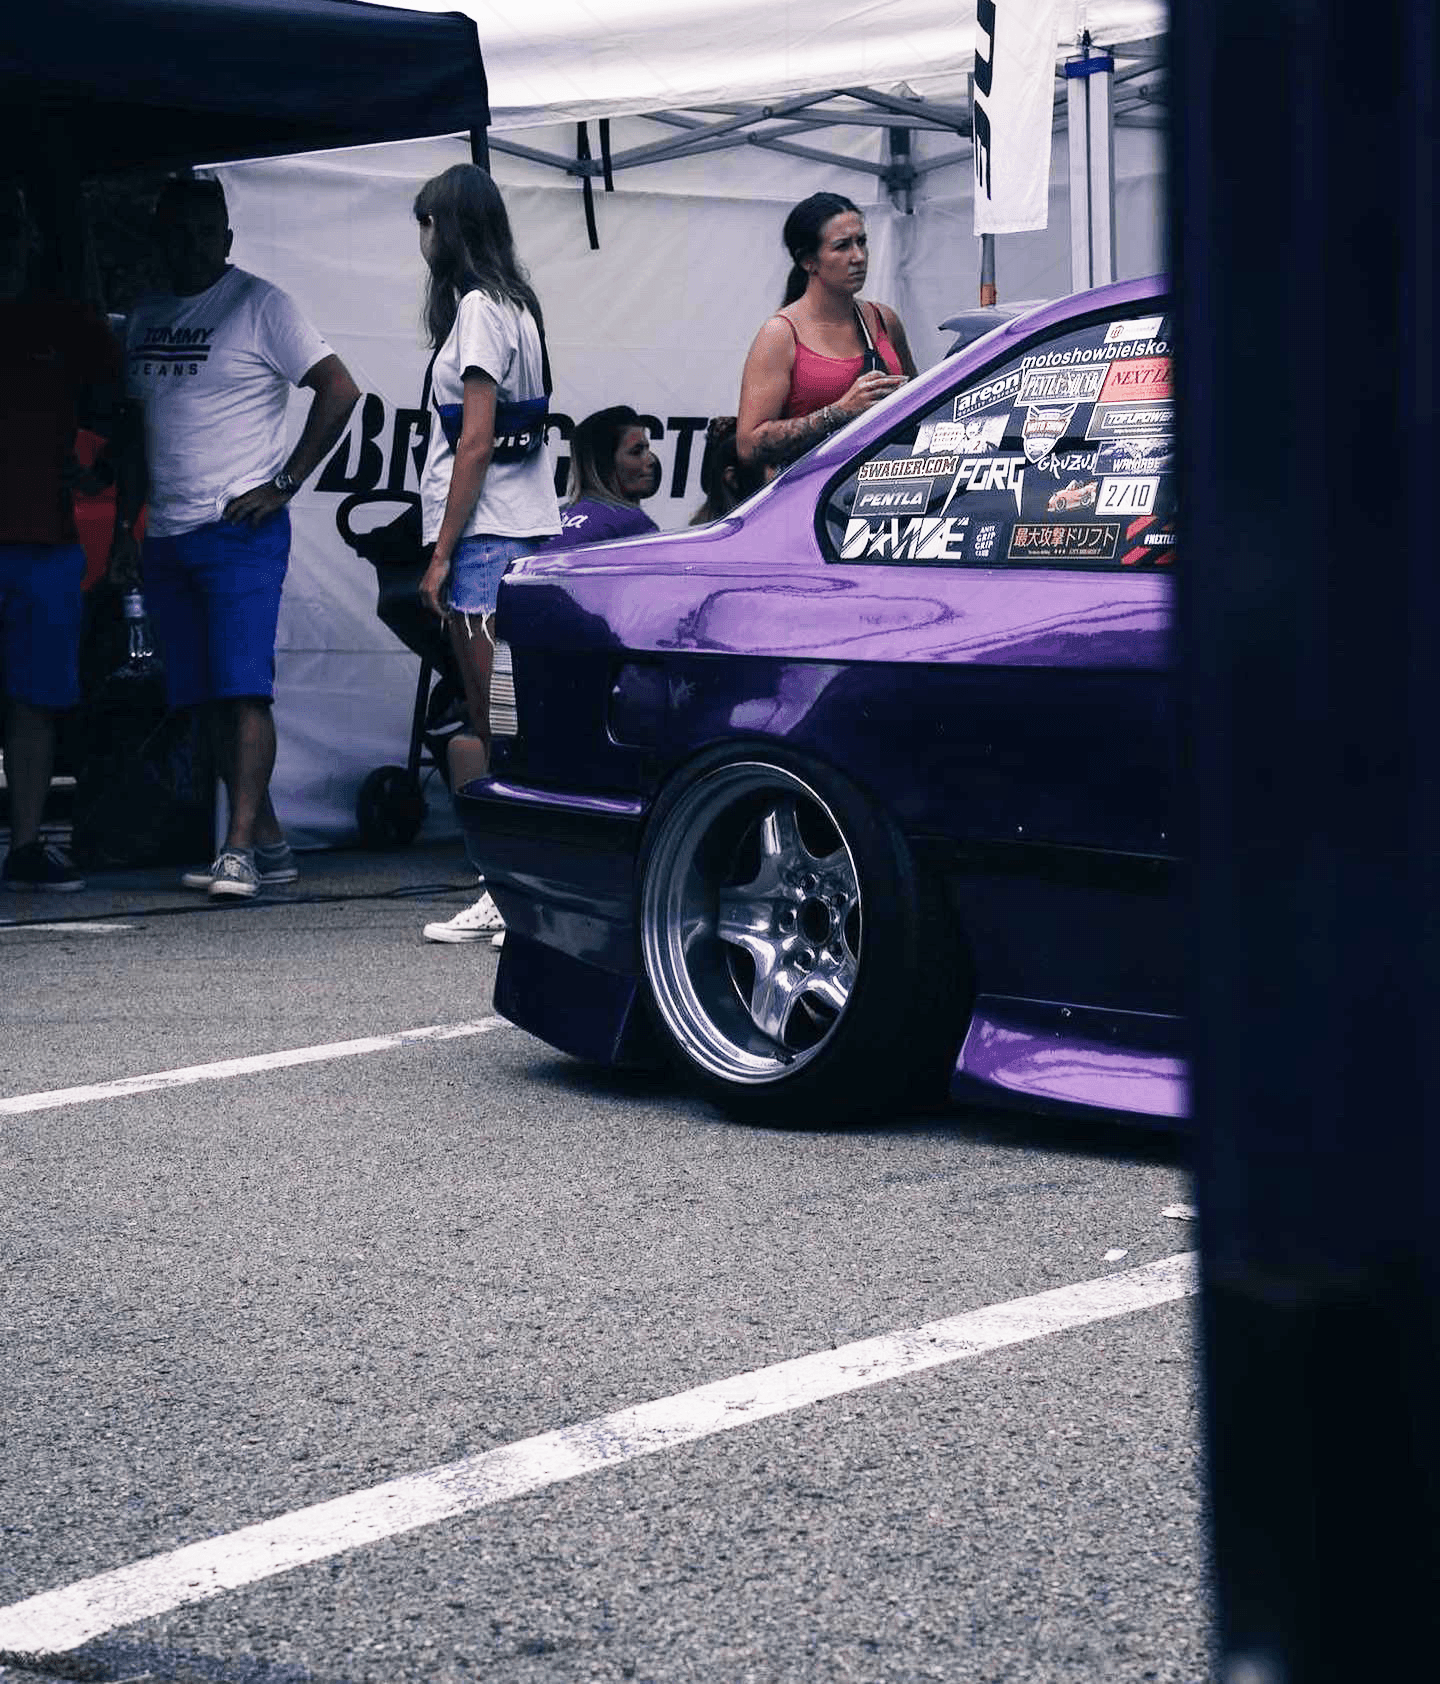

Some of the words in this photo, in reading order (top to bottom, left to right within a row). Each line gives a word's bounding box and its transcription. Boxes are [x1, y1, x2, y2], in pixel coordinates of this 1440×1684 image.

[144, 327, 215, 343] TOMMY
[131, 362, 199, 377] JEANS
[1111, 369, 1154, 386] NEXT
[958, 373, 1020, 410] areon
[859, 491, 923, 507] PENTLA
[1105, 484, 1151, 507] 2/10
[976, 532, 996, 543] GRIP
[1014, 527, 1115, 547] 最大攻撃ドリフト
[974, 541, 994, 551] GRIP
